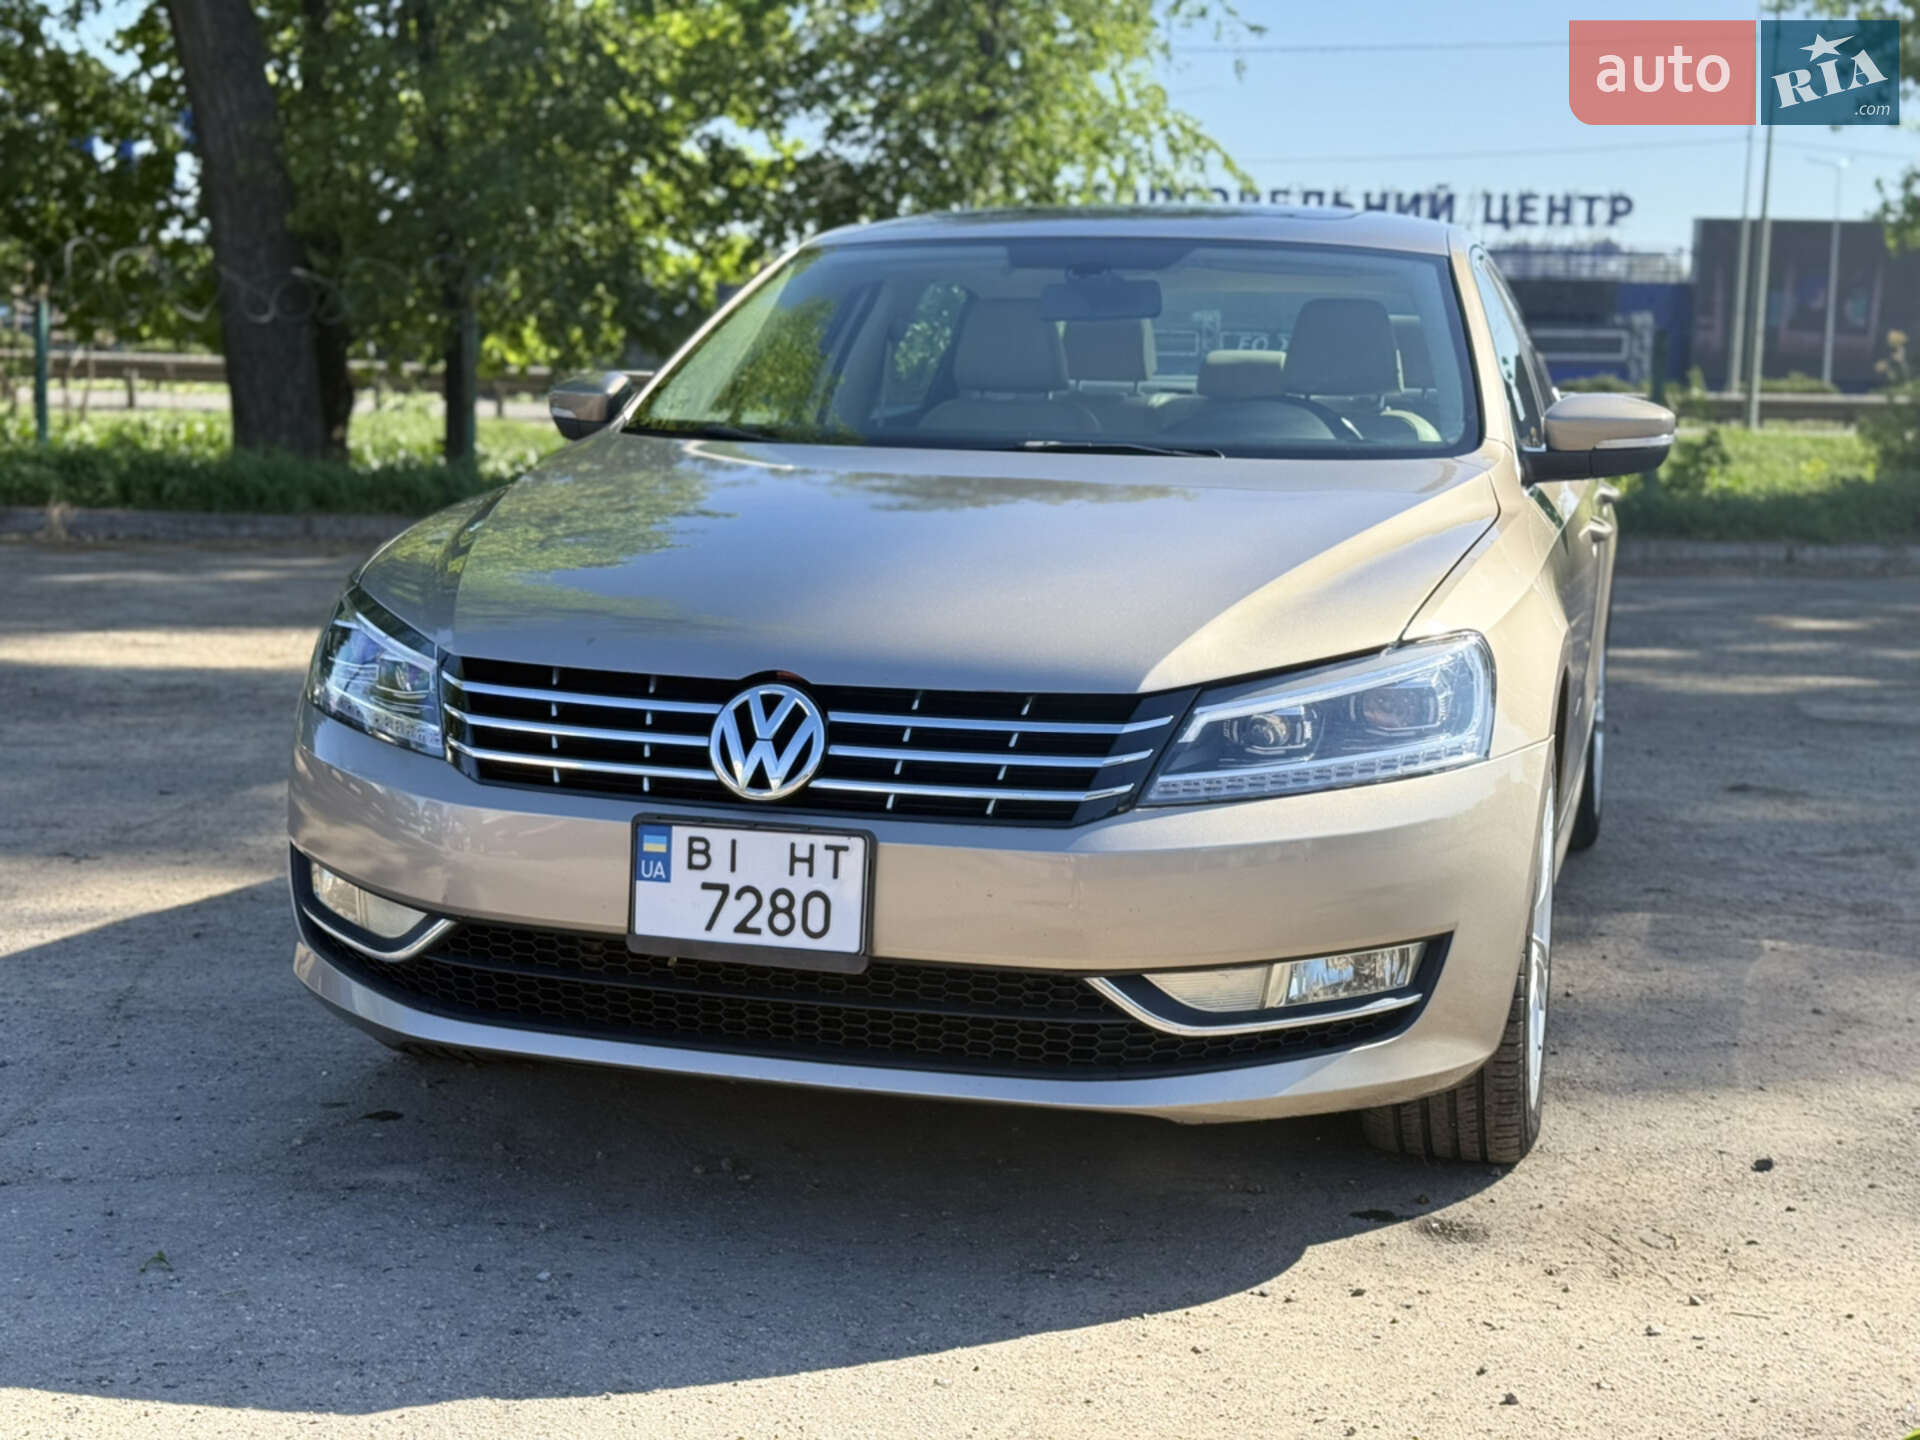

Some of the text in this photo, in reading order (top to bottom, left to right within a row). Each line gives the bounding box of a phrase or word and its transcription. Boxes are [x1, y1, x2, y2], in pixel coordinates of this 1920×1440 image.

[1482, 191, 1634, 230] ЦЕНТР
[640, 860, 666, 879] UA
[788, 841, 850, 879] HT
[700, 882, 832, 939] 7280
